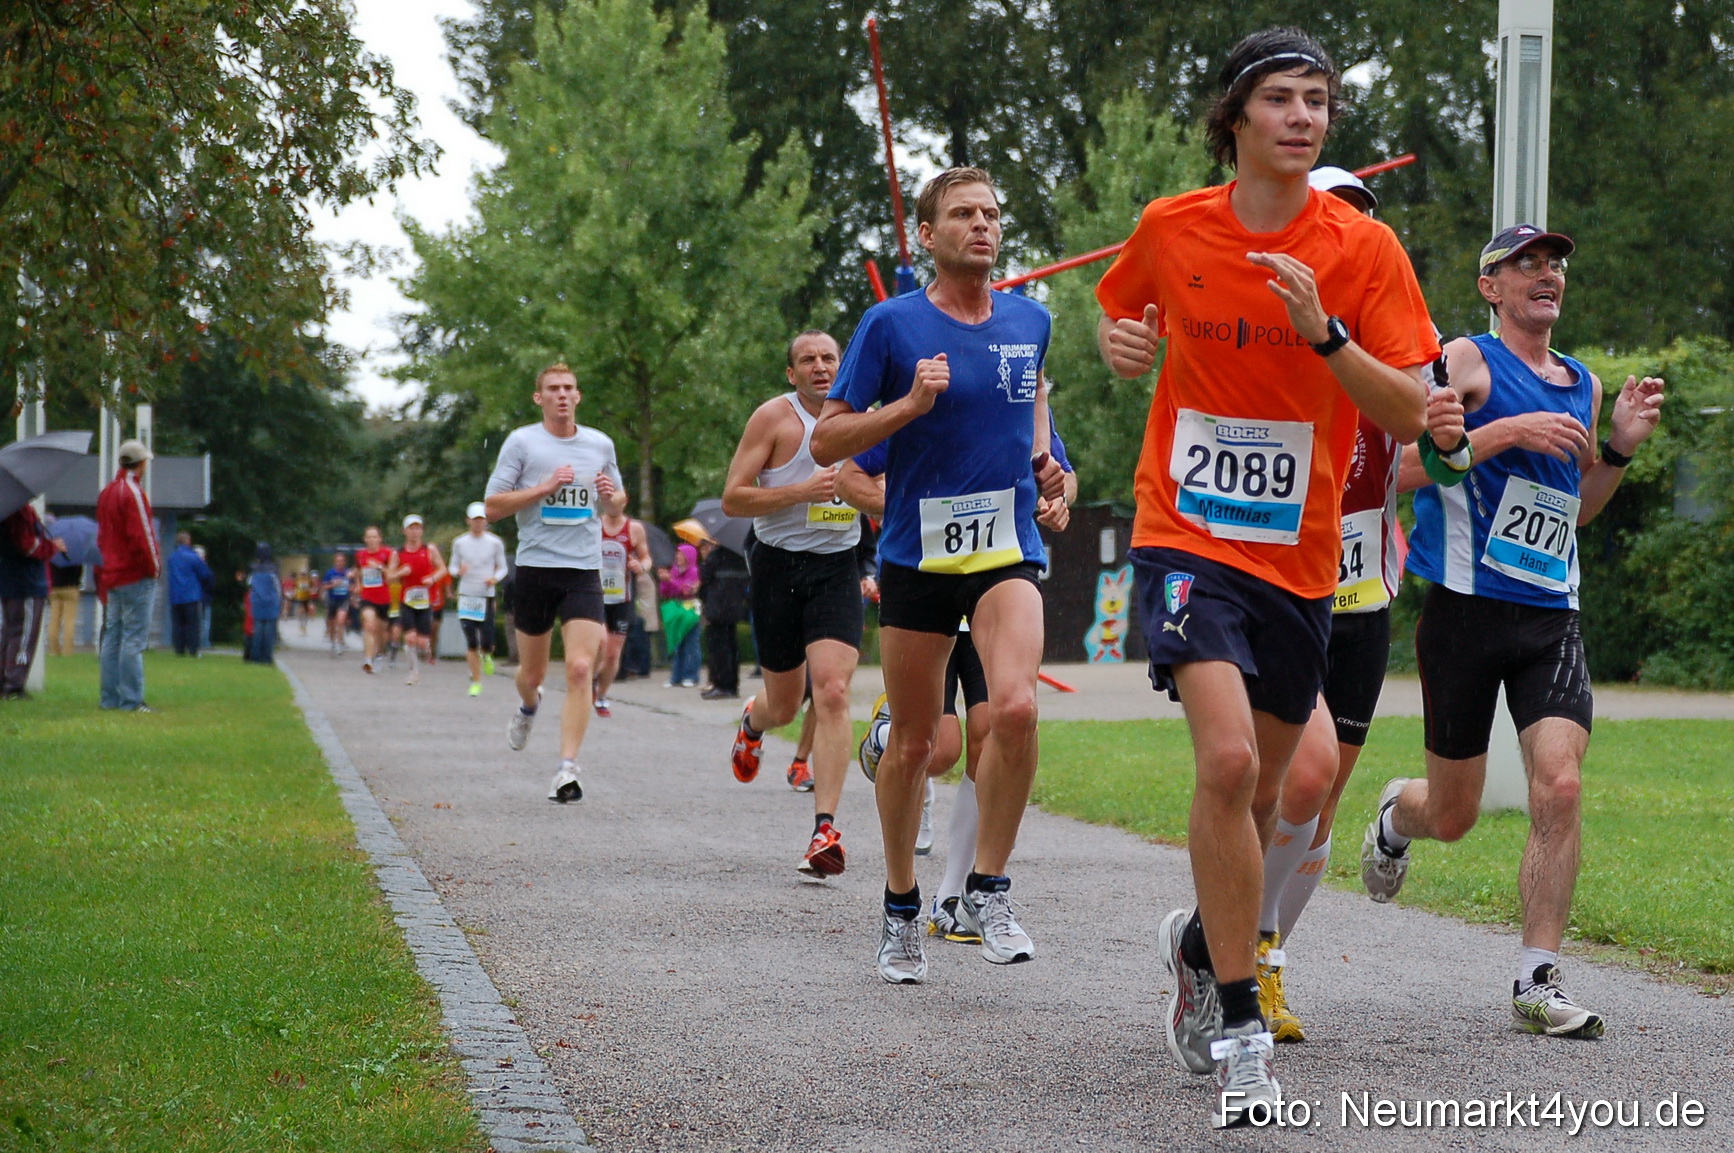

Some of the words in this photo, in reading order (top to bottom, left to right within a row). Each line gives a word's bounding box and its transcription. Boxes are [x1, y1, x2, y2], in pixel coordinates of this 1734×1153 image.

[1182, 318, 1231, 341] EURO
[1255, 326, 1310, 346] POLE
[1216, 425, 1270, 439] BOCK
[1184, 445, 1296, 498] 2089
[952, 498, 991, 512] BOCK
[1536, 491, 1567, 508] BOCK
[1200, 500, 1271, 524] Matthias
[945, 516, 996, 554] 811
[1501, 505, 1569, 555] 2070
[1520, 551, 1549, 573] Hans
